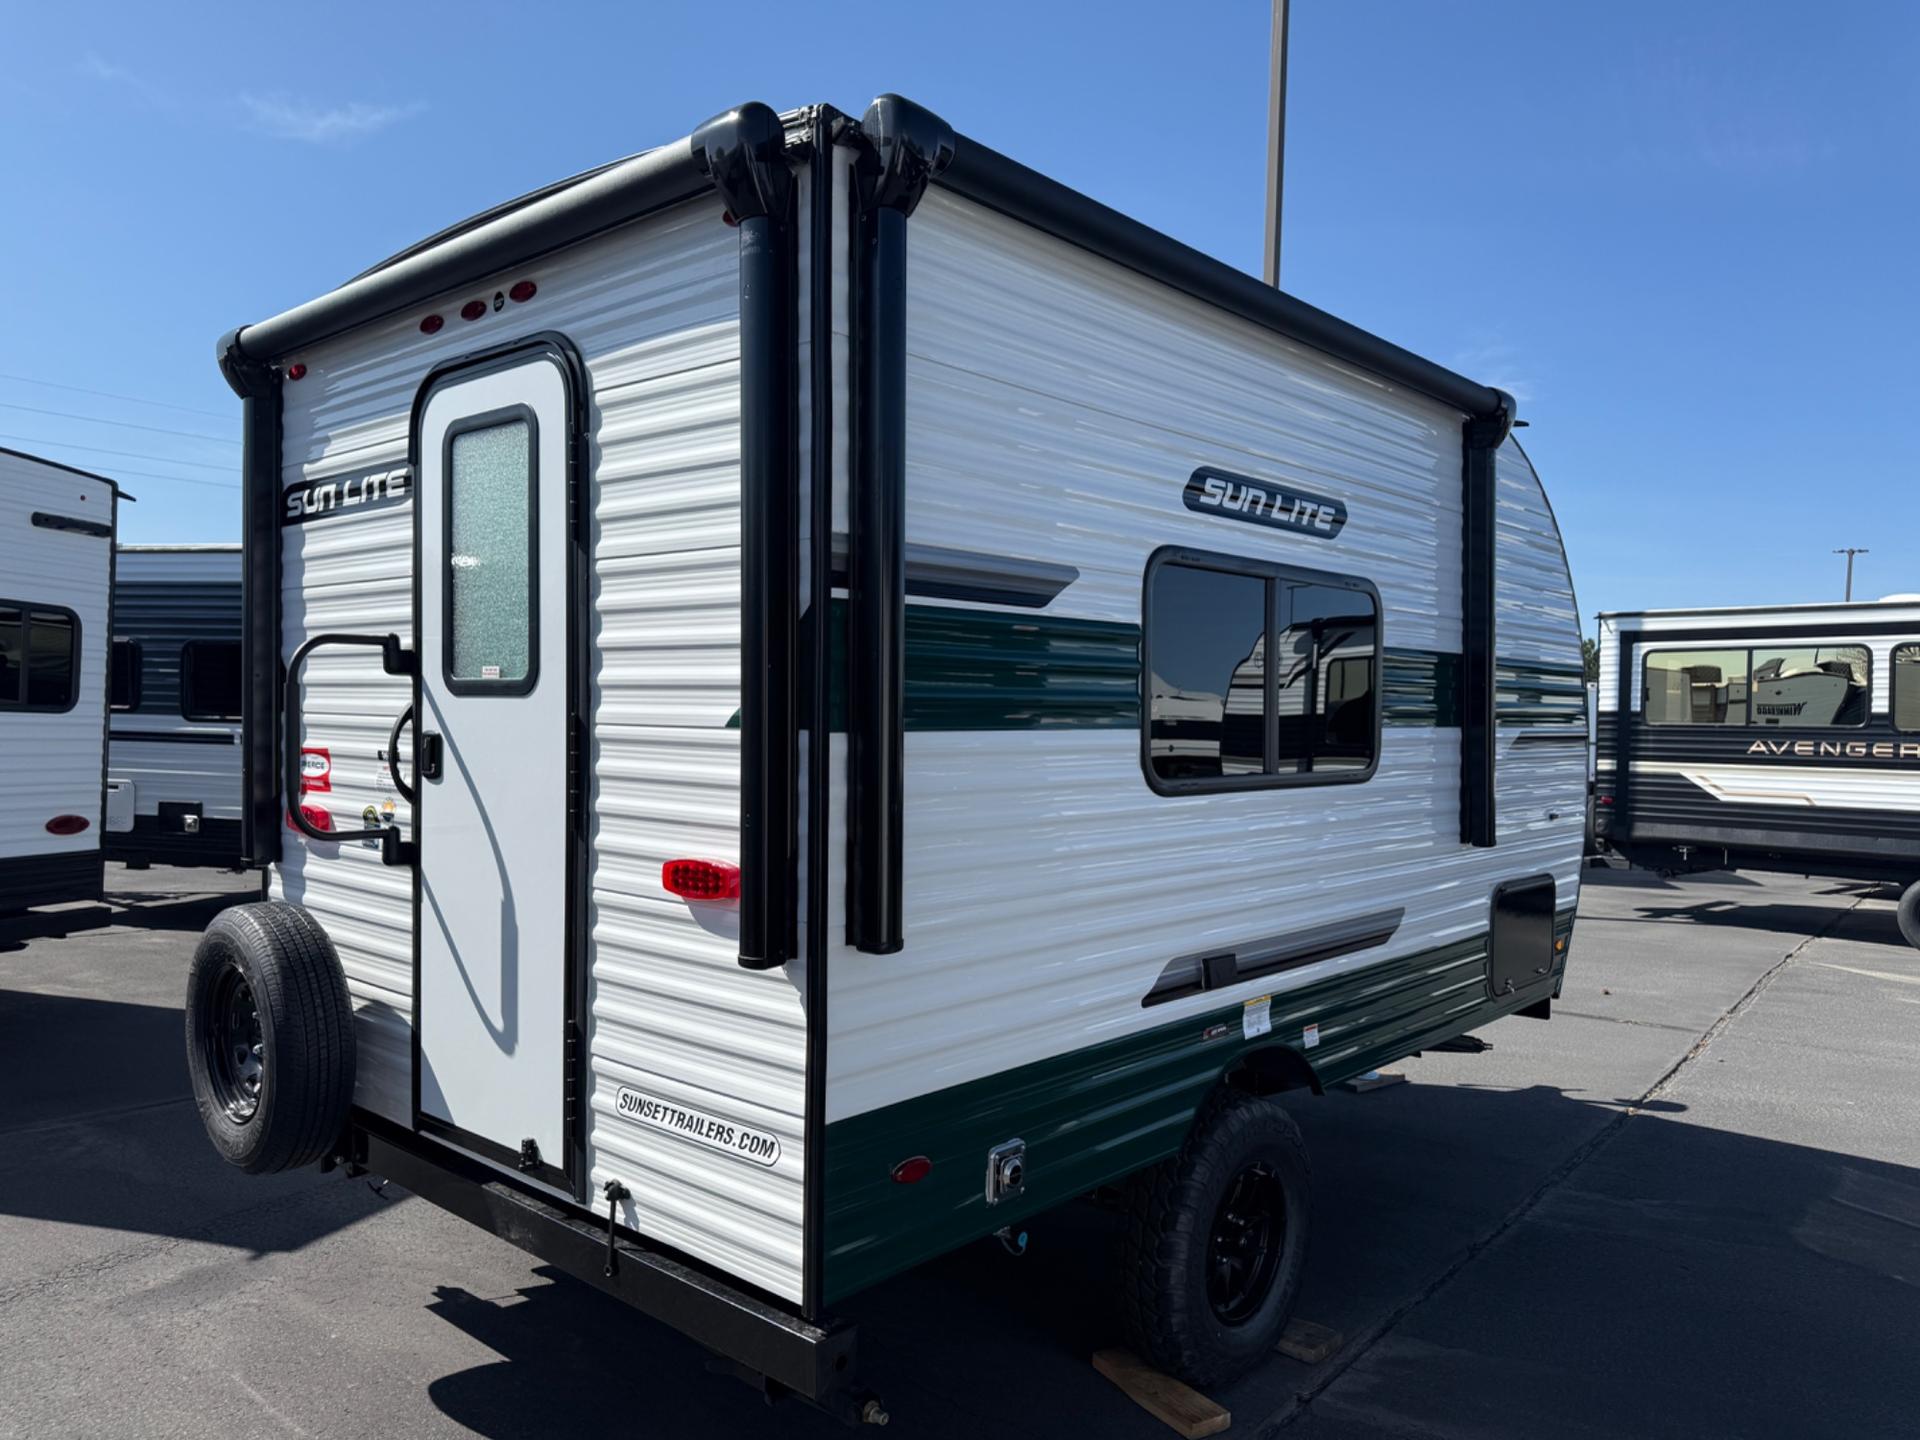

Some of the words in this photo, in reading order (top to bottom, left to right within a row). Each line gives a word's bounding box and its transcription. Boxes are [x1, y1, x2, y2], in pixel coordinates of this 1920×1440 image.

[287, 483, 337, 518] SUN
[342, 467, 409, 507] LITE
[1199, 477, 1267, 516] SUN
[1271, 494, 1336, 531] LITE
[619, 1093, 776, 1159] SUNSETTRAILERS.COM
